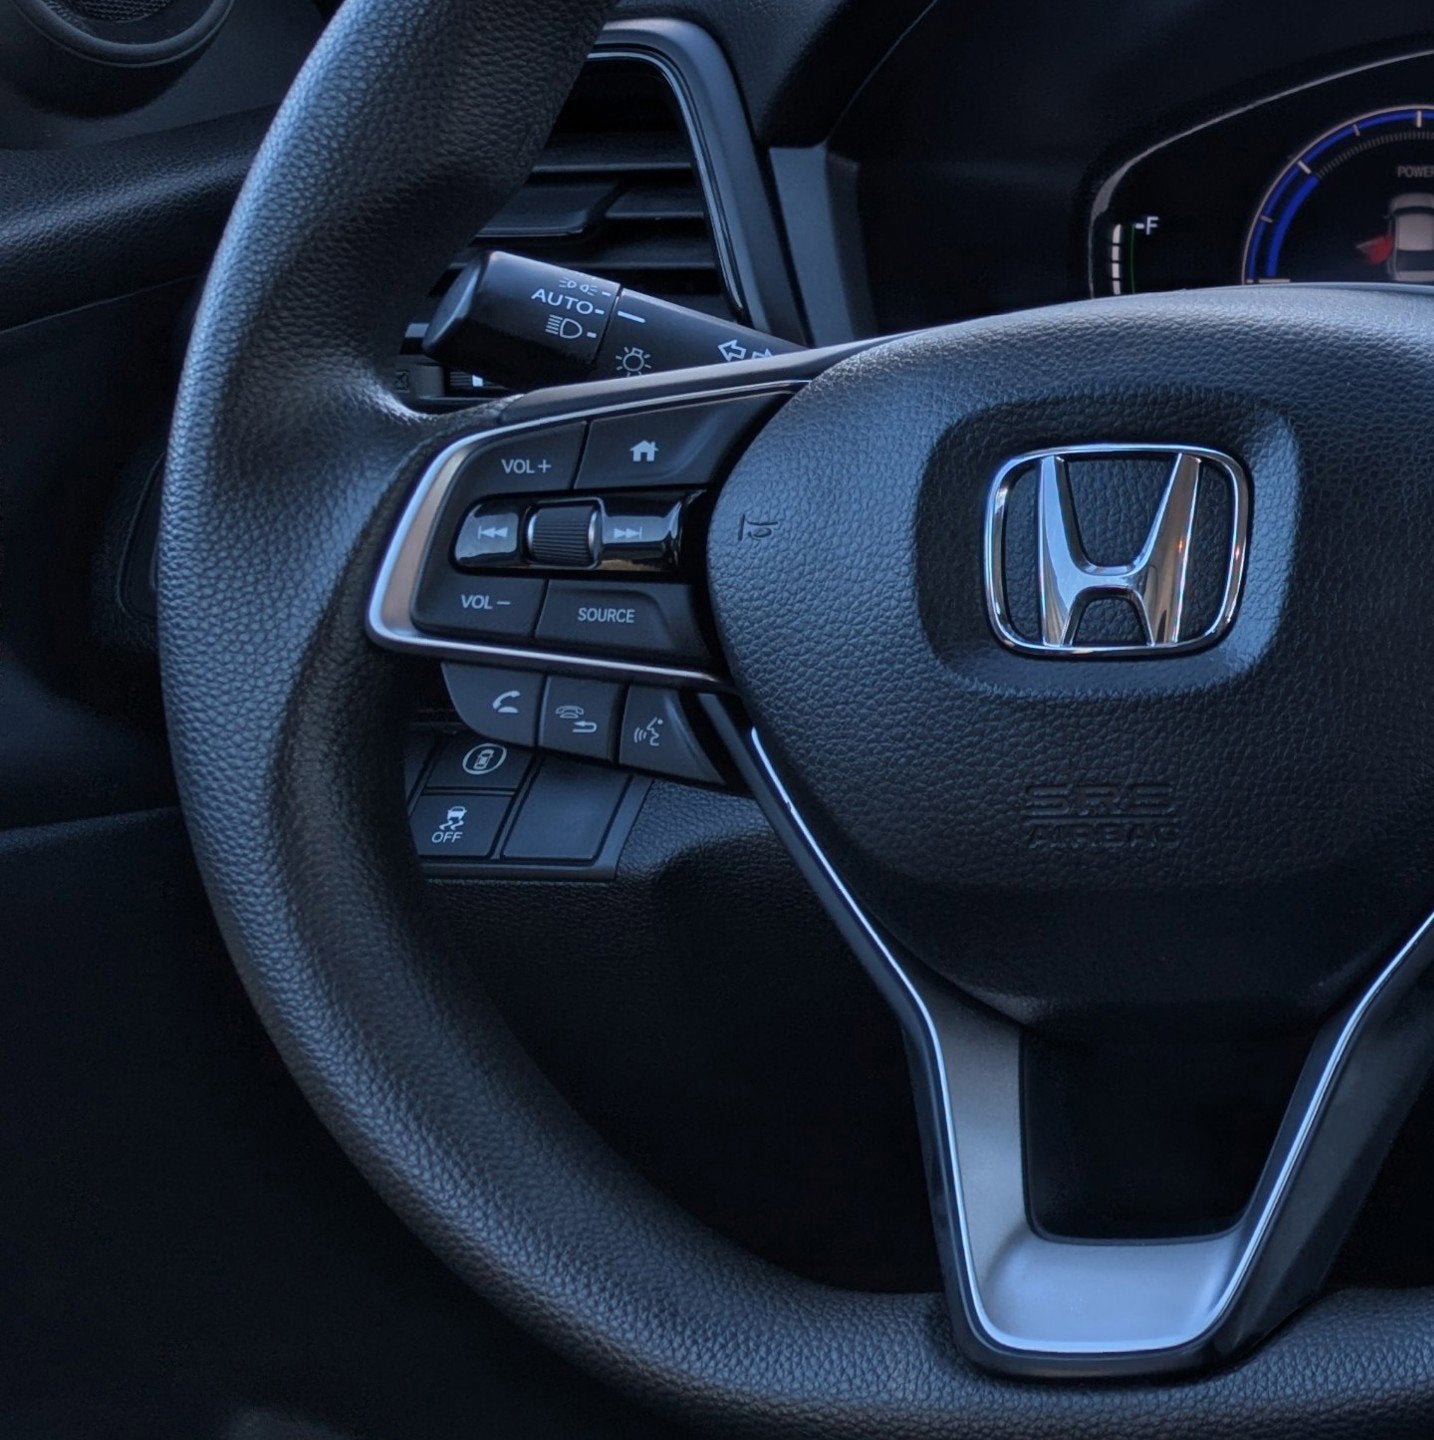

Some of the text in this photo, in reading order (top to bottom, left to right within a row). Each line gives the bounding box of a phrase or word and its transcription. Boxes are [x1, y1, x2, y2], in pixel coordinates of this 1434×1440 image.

[1146, 216, 1159, 235] F
[531, 287, 594, 316] AUTO
[577, 606, 635, 625] SOURCE
[431, 829, 464, 844] OFF
